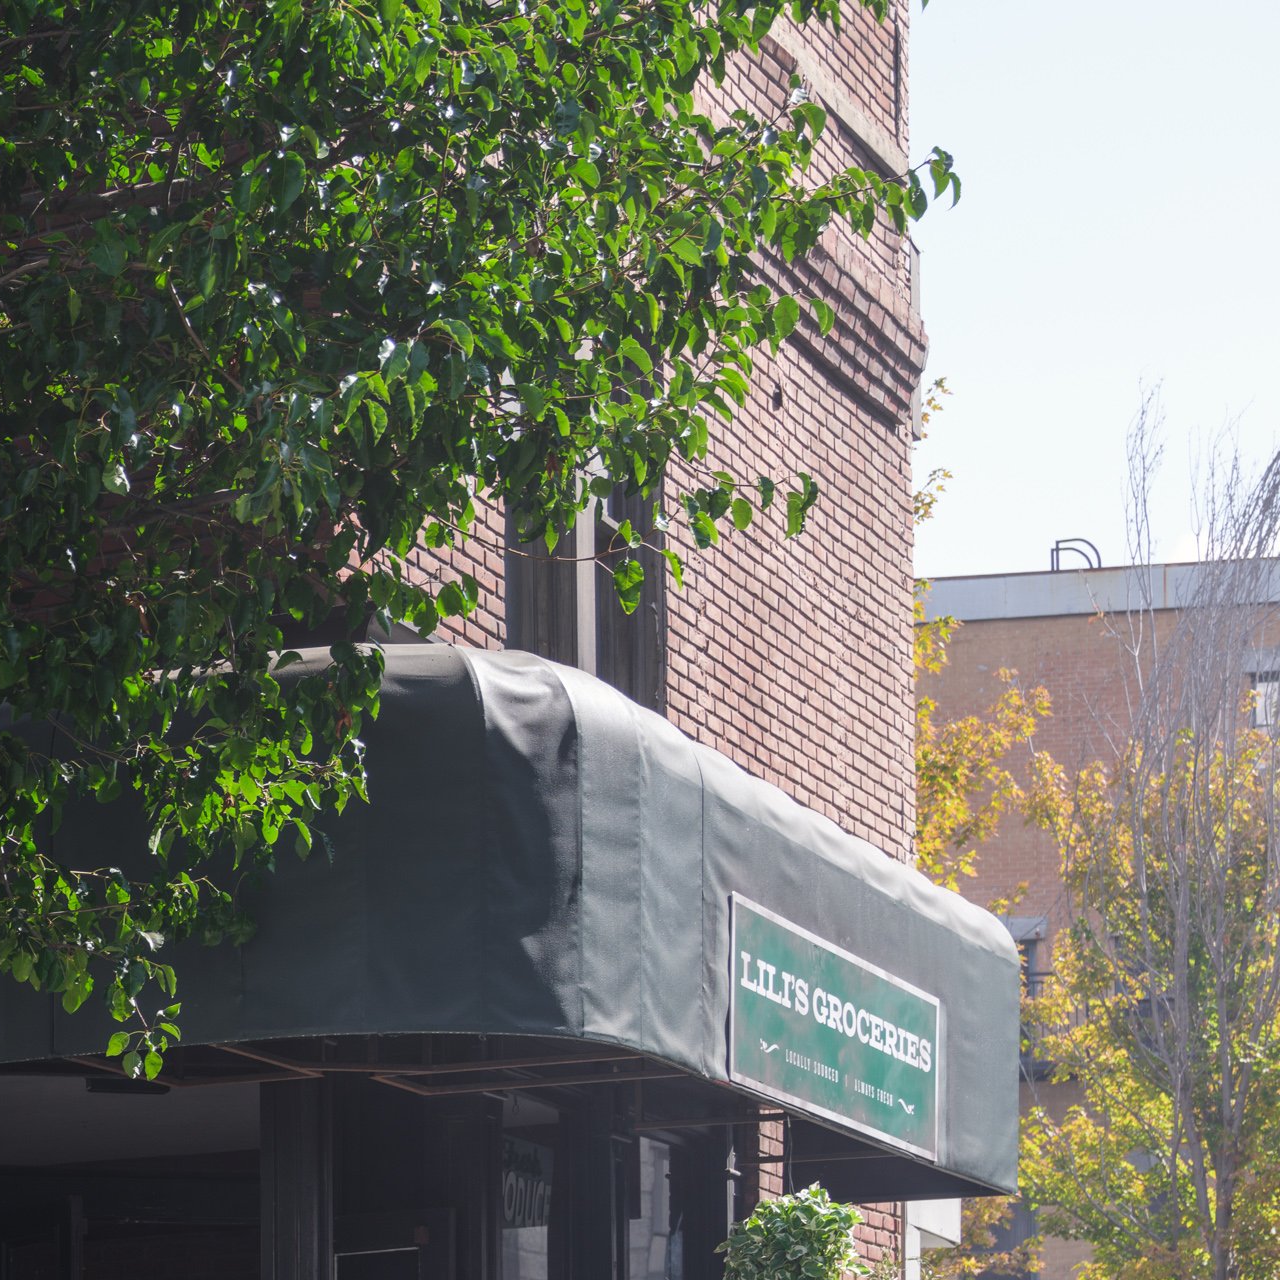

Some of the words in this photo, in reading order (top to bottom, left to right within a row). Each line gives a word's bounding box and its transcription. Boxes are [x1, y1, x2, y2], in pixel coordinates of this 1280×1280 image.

[740, 951, 810, 1016] LILI'S
[812, 987, 932, 1073] GROCERIES
[785, 1048, 811, 1071] LOCALLY
[813, 1059, 839, 1084] SOURCED
[854, 1078, 875, 1099] ALWAYS
[876, 1087, 894, 1107] FRESH
